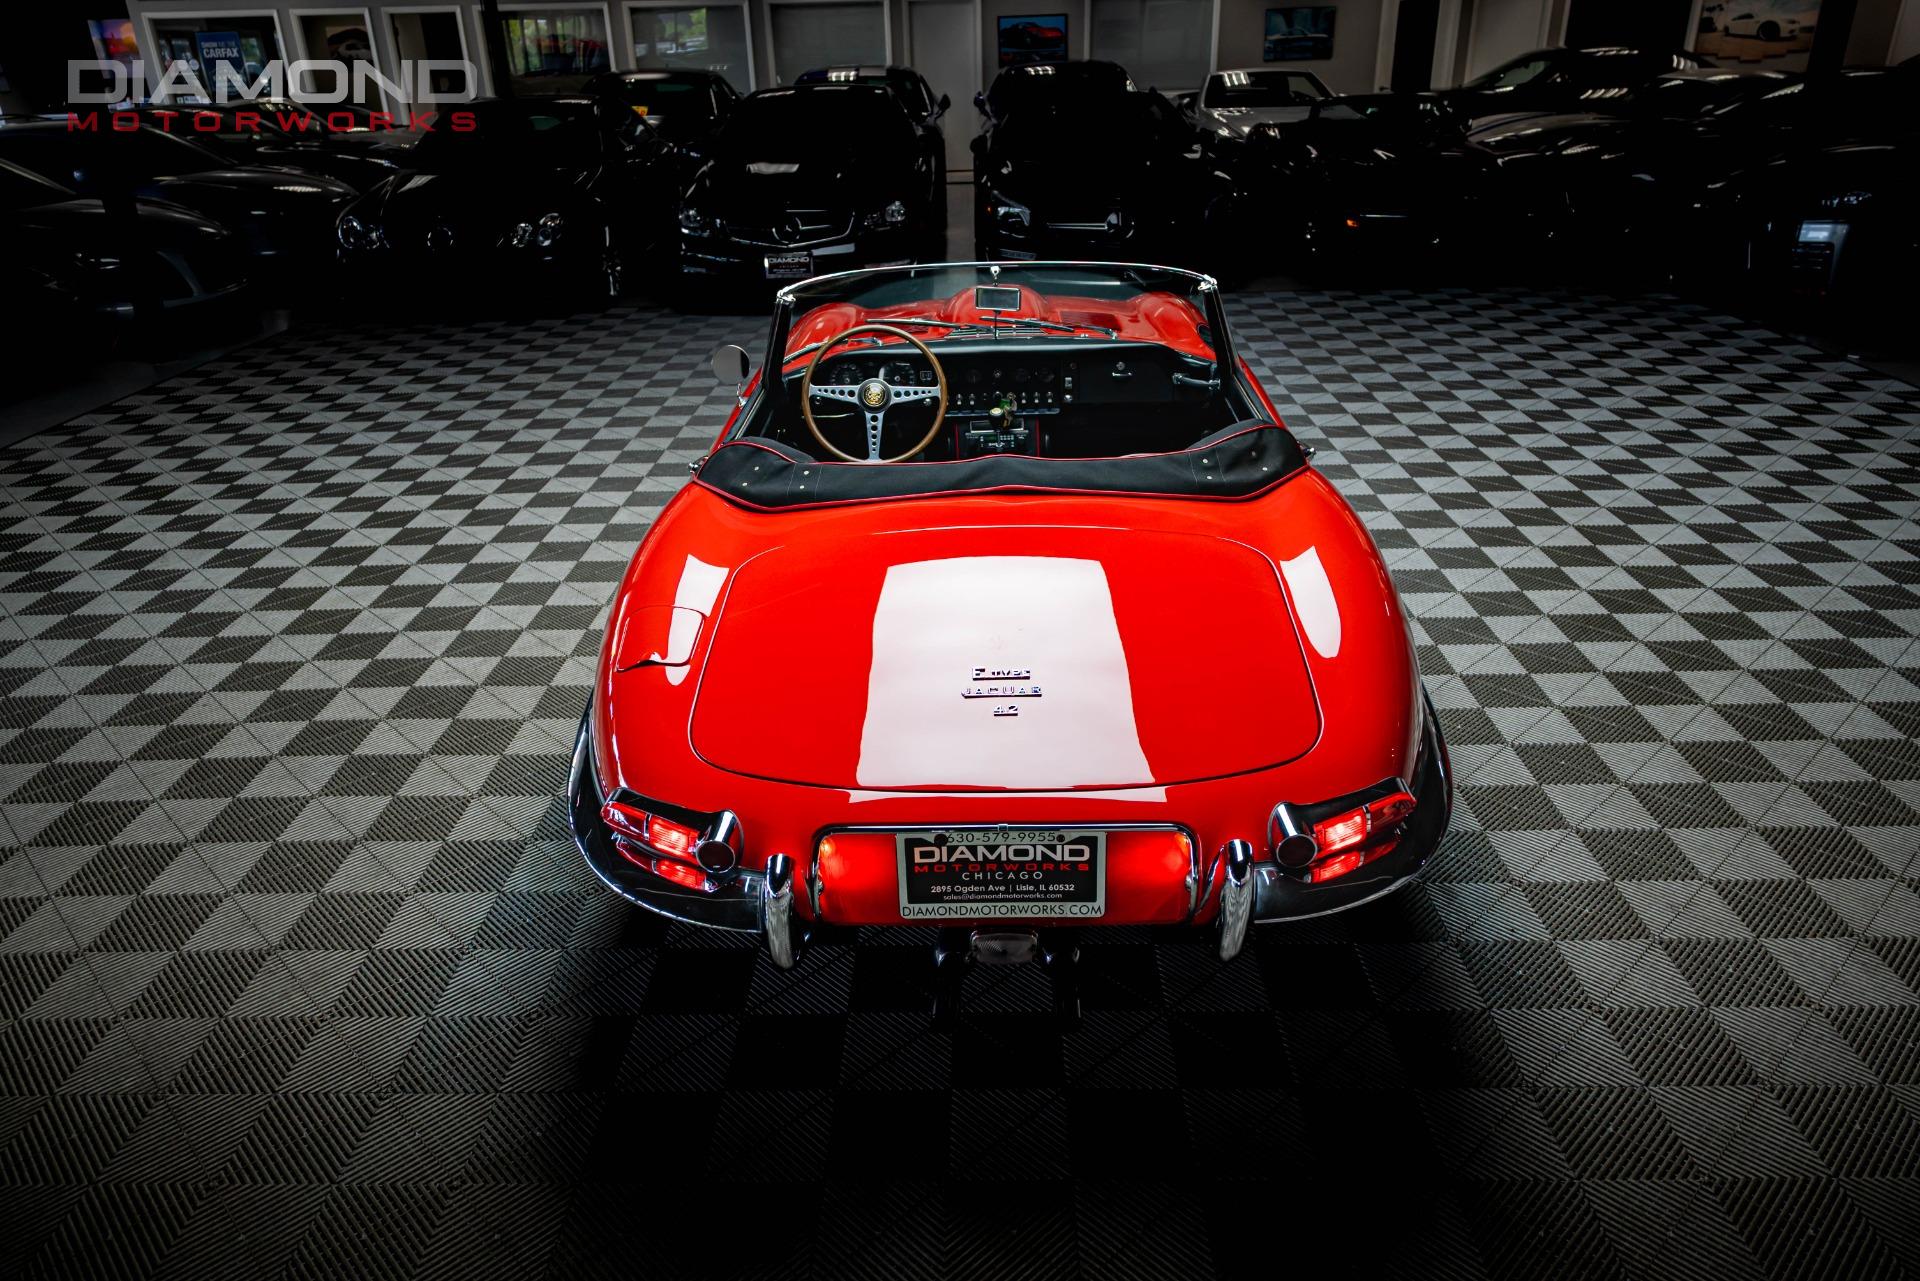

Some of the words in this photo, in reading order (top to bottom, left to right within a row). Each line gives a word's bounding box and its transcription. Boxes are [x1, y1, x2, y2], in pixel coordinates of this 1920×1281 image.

[203, 48, 239, 58] CARFAX
[769, 256, 810, 264] DIAMOND
[961, 685, 1043, 699] JAGUAR
[947, 832, 1056, 843] 630-579-9955
[913, 844, 1090, 863] DIAMOND
[913, 863, 1090, 873] MOTORWORKS
[961, 871, 1043, 880] CHICAGO
[930, 885, 952, 893] 2895
[954, 884, 986, 894] Ogden
[988, 884, 1006, 892] Ave
[1016, 884, 1037, 892] Lisle,
[943, 892, 1062, 901] sales@diamondmotorworks.com
[902, 904, 1102, 917] DIAMONDMOTORWORKS.COM
